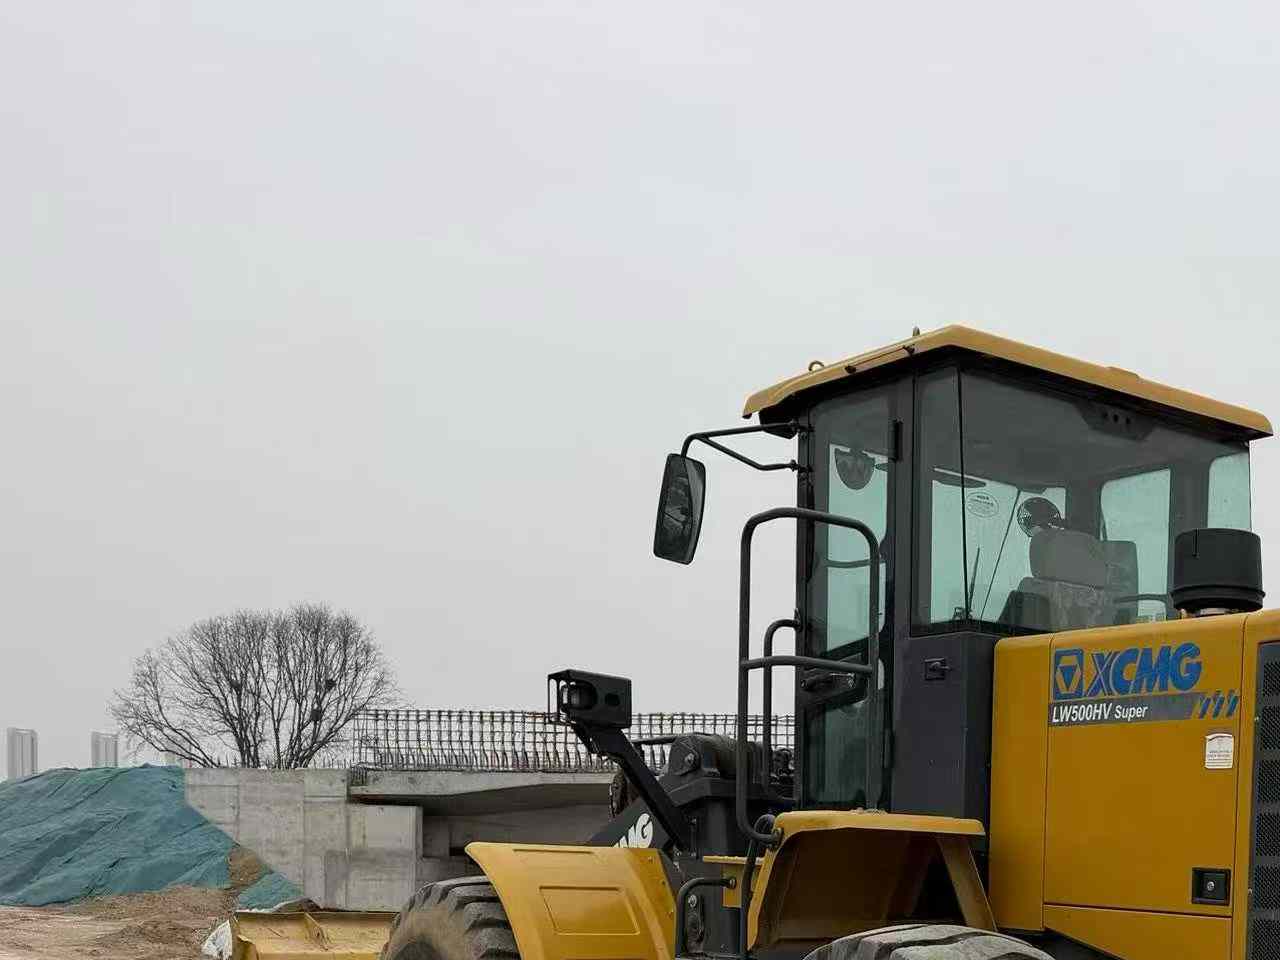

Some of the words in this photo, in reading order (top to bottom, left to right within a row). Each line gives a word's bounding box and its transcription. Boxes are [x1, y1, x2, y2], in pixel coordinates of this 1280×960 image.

[1087, 642, 1203, 697] XCMG
[1053, 702, 1113, 724] LW500HV
[1114, 704, 1149, 722] Super
